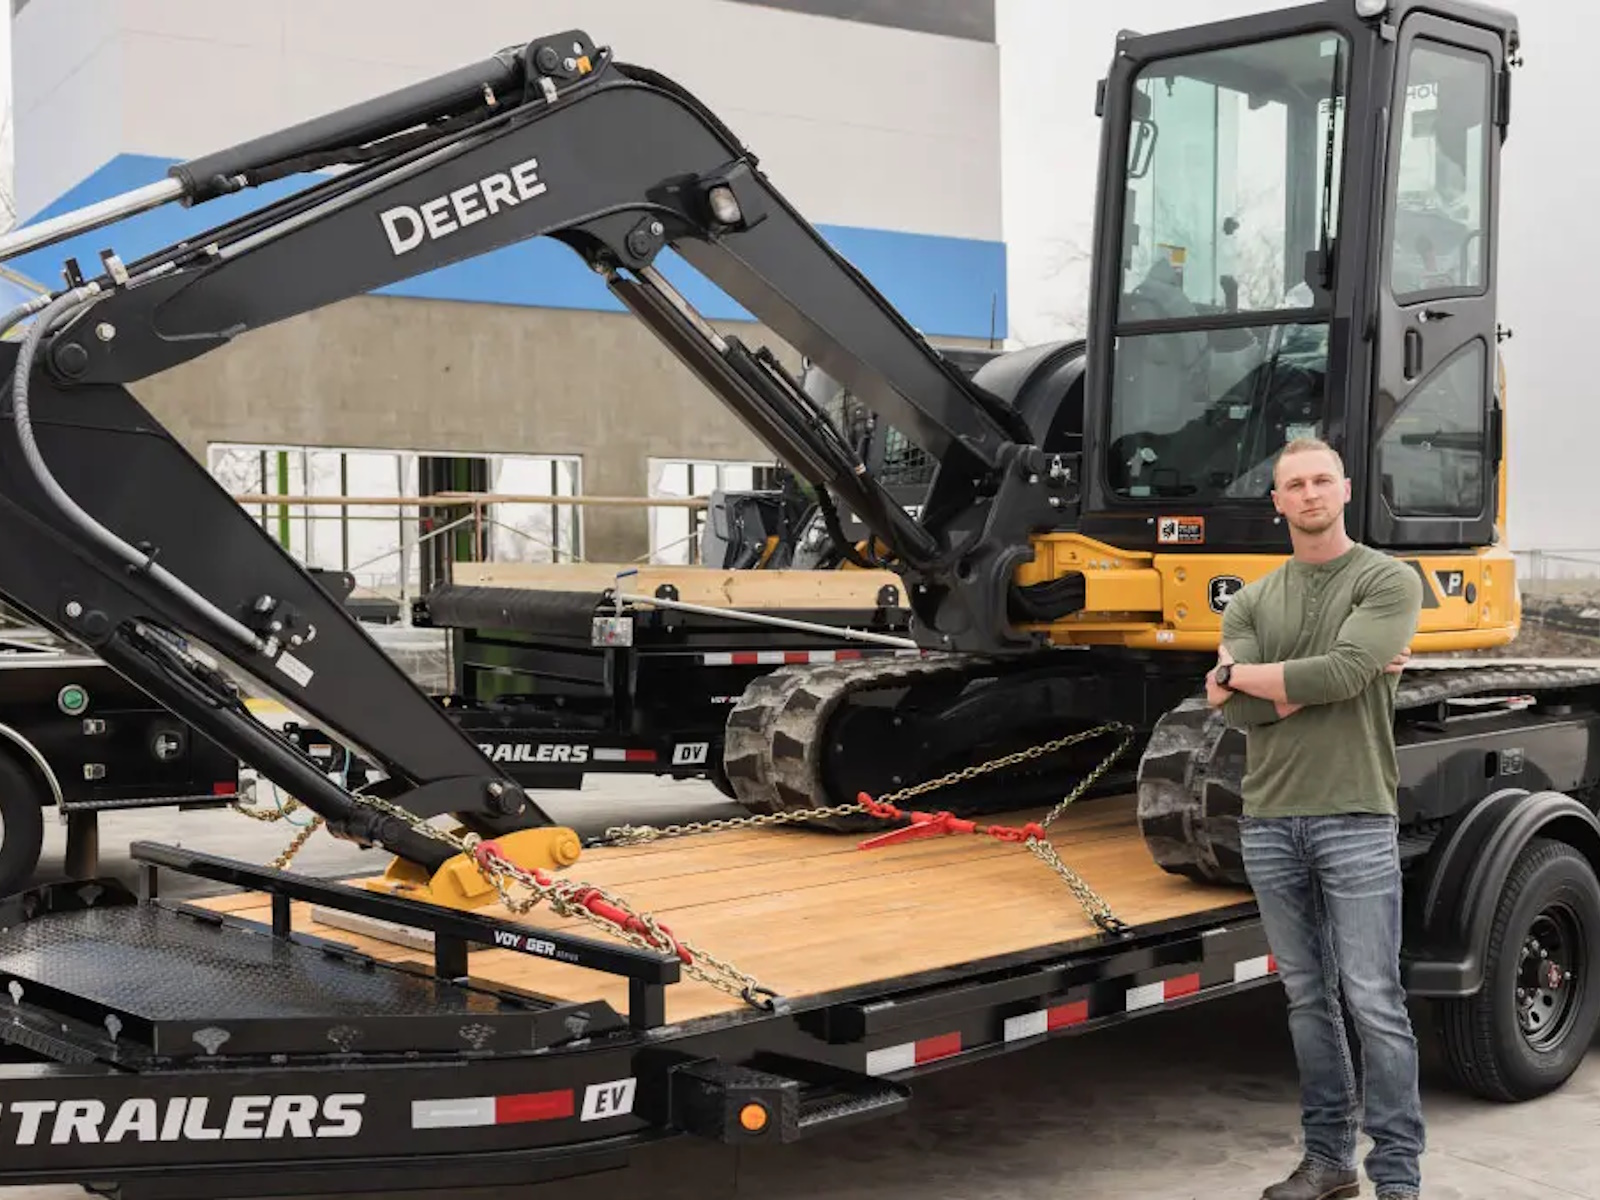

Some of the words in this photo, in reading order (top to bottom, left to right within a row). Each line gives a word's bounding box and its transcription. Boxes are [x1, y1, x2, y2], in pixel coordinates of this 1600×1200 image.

[380, 157, 547, 256] DEERE
[477, 743, 589, 763] RAILERS
[681, 745, 703, 760] DV
[493, 930, 556, 955] VOYAGER
[595, 1085, 626, 1113] EV
[10, 1093, 366, 1145] TRAILERS
